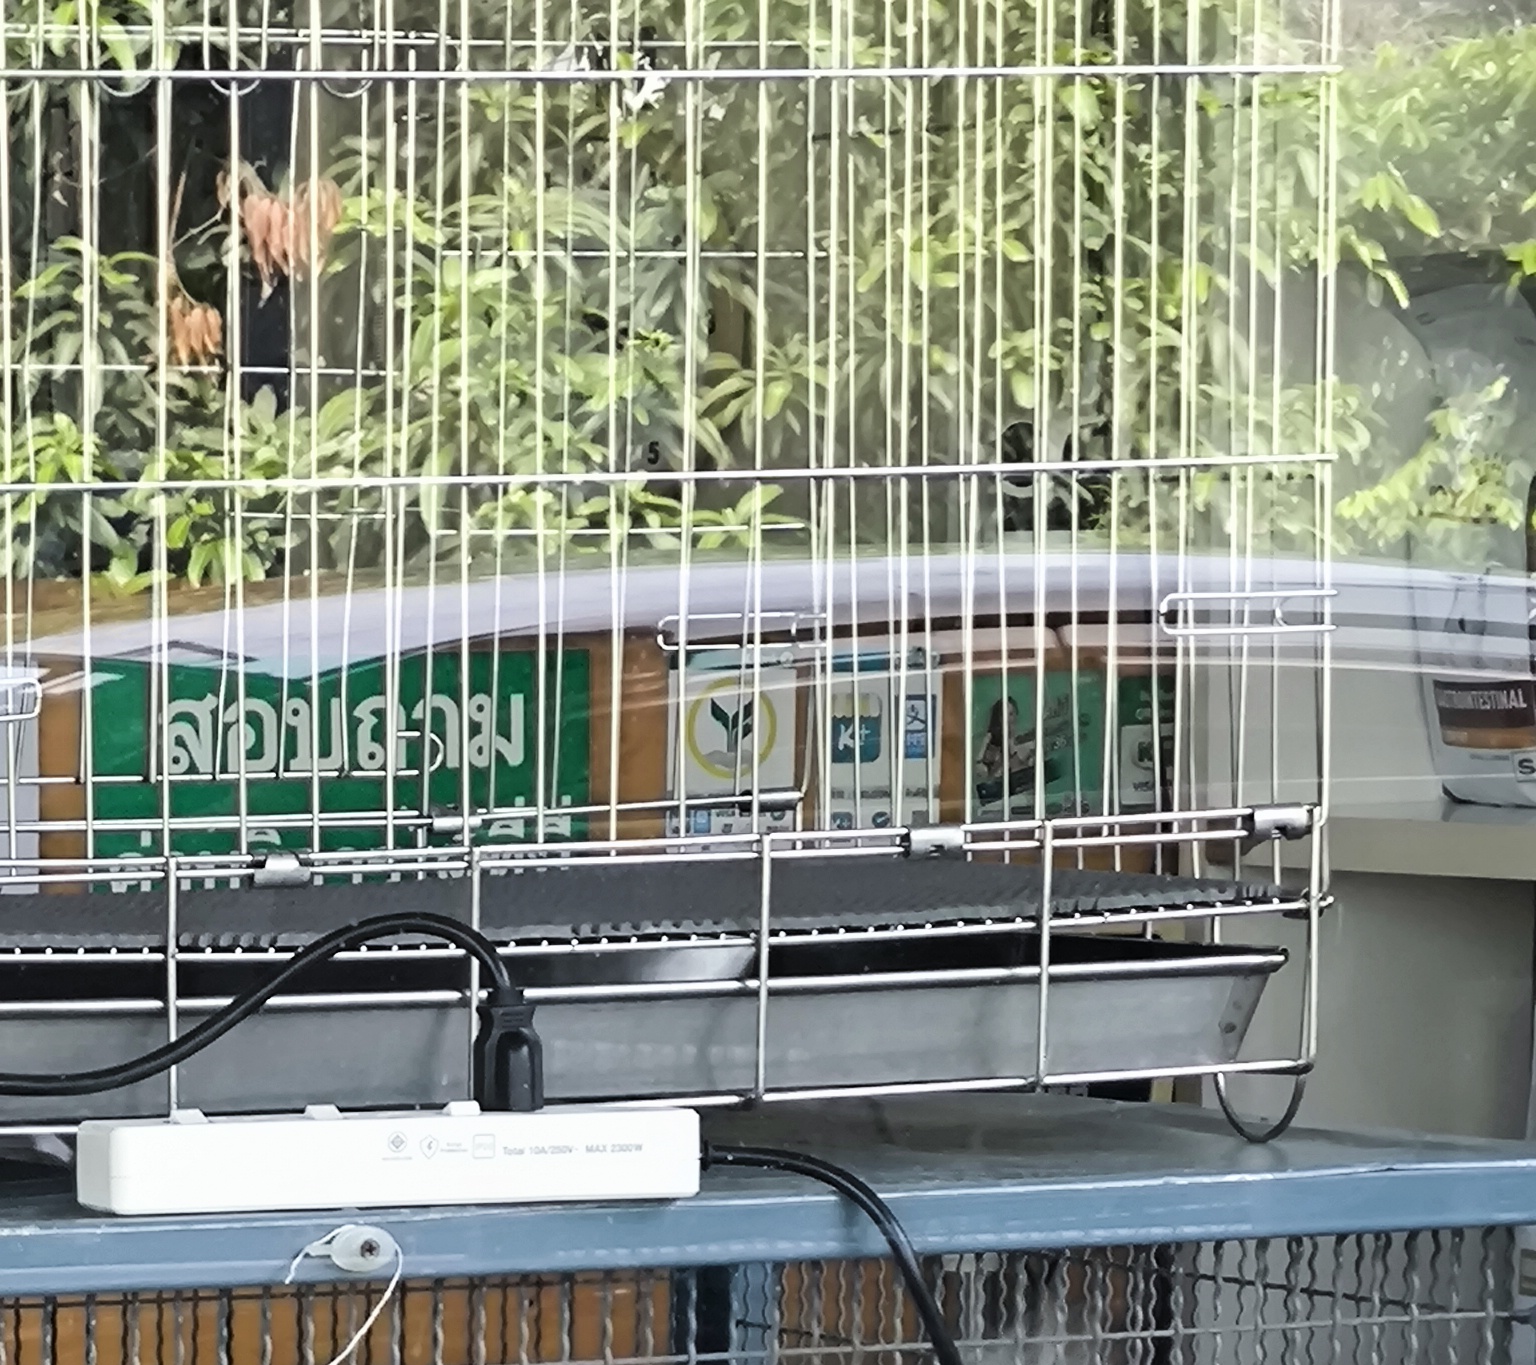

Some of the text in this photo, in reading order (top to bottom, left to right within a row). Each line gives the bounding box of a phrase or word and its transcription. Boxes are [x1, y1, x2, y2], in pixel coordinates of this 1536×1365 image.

[167, 692, 526, 775] สอบถาม
[585, 1143, 607, 1153] MAX
